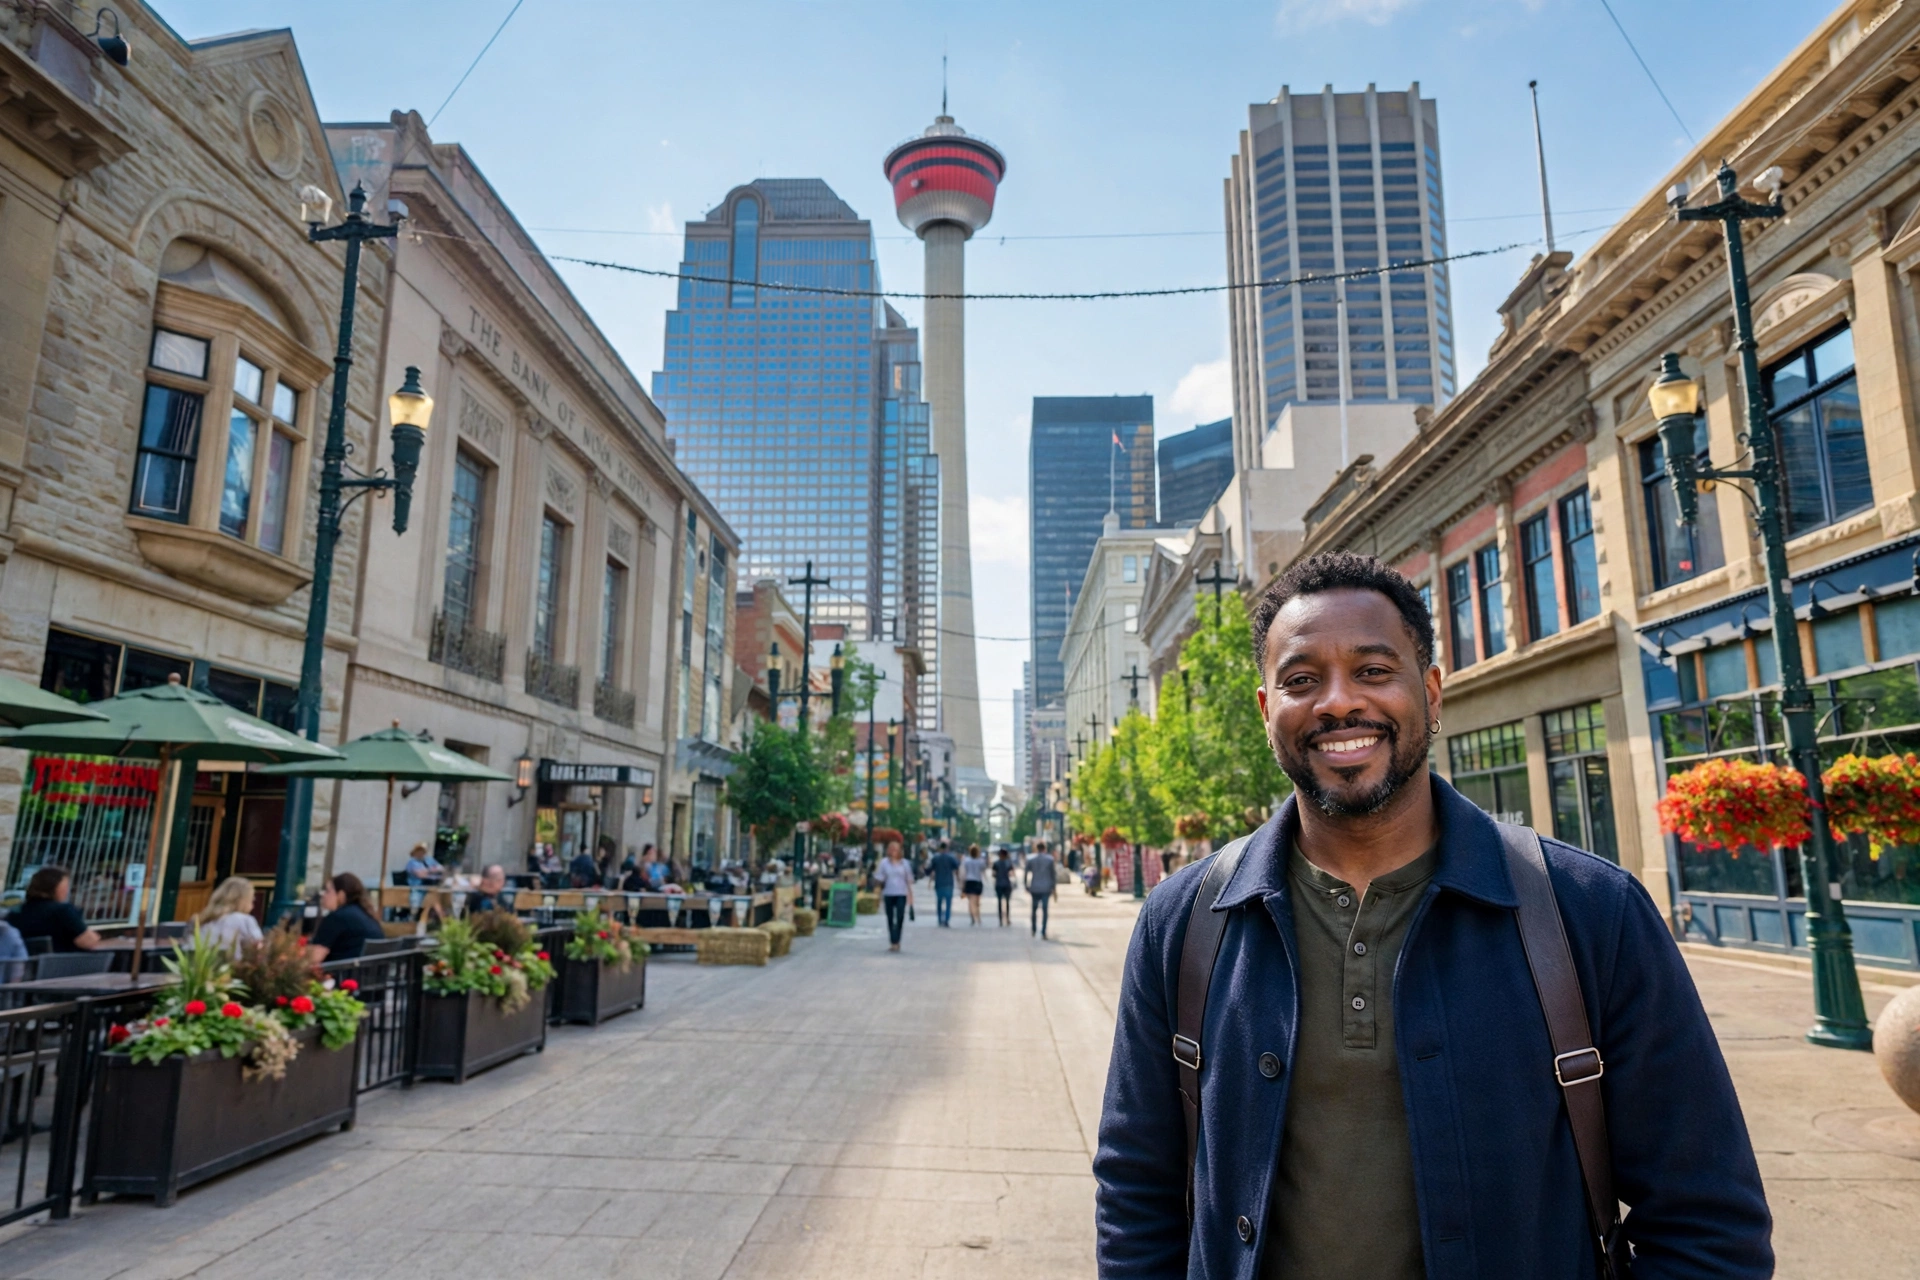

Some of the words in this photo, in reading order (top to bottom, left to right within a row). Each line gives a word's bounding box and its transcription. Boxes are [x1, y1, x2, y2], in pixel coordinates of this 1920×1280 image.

[469, 305, 501, 357] THE
[511, 351, 549, 407] BANK
[558, 401, 576, 431] OF
